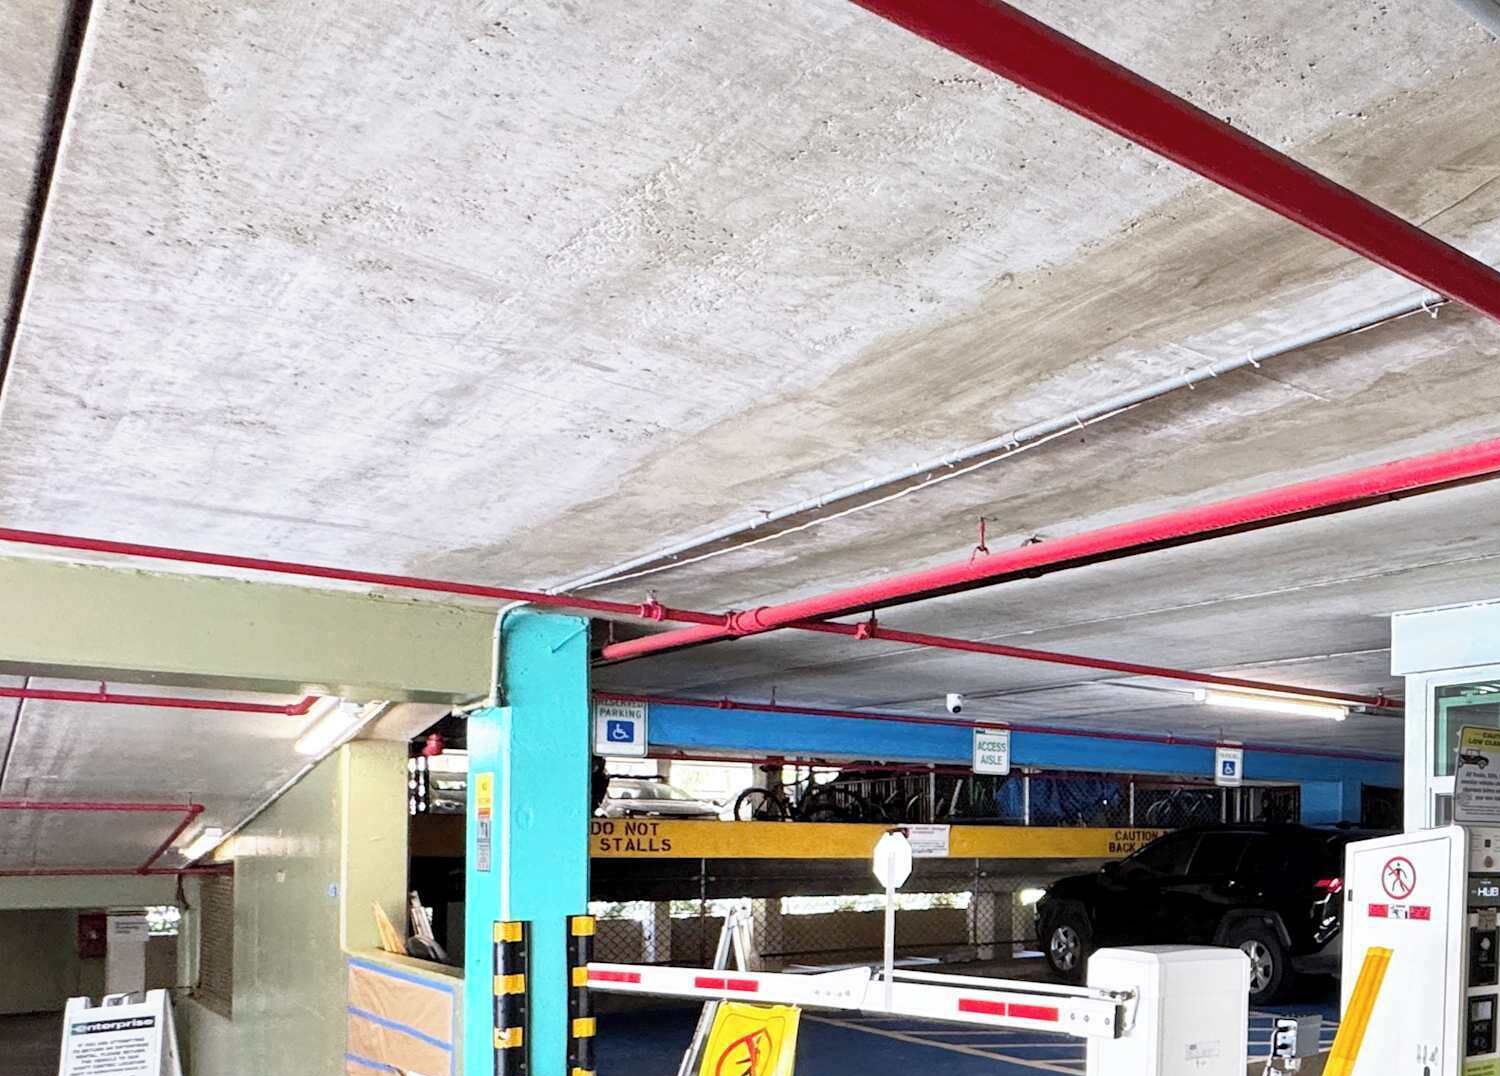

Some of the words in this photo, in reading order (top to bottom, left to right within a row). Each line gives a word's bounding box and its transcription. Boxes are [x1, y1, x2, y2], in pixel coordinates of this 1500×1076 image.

[600, 708, 642, 719] PARKING
[977, 741, 1007, 752] ACCESS
[981, 754, 1003, 765] AISLE
[591, 822, 614, 835] DO
[625, 823, 660, 835] NOT
[600, 838, 672, 851] STALLS
[1109, 842, 1136, 853] BACK
[1478, 886, 1500, 897] HUB
[73, 1018, 155, 1033] enterprise
